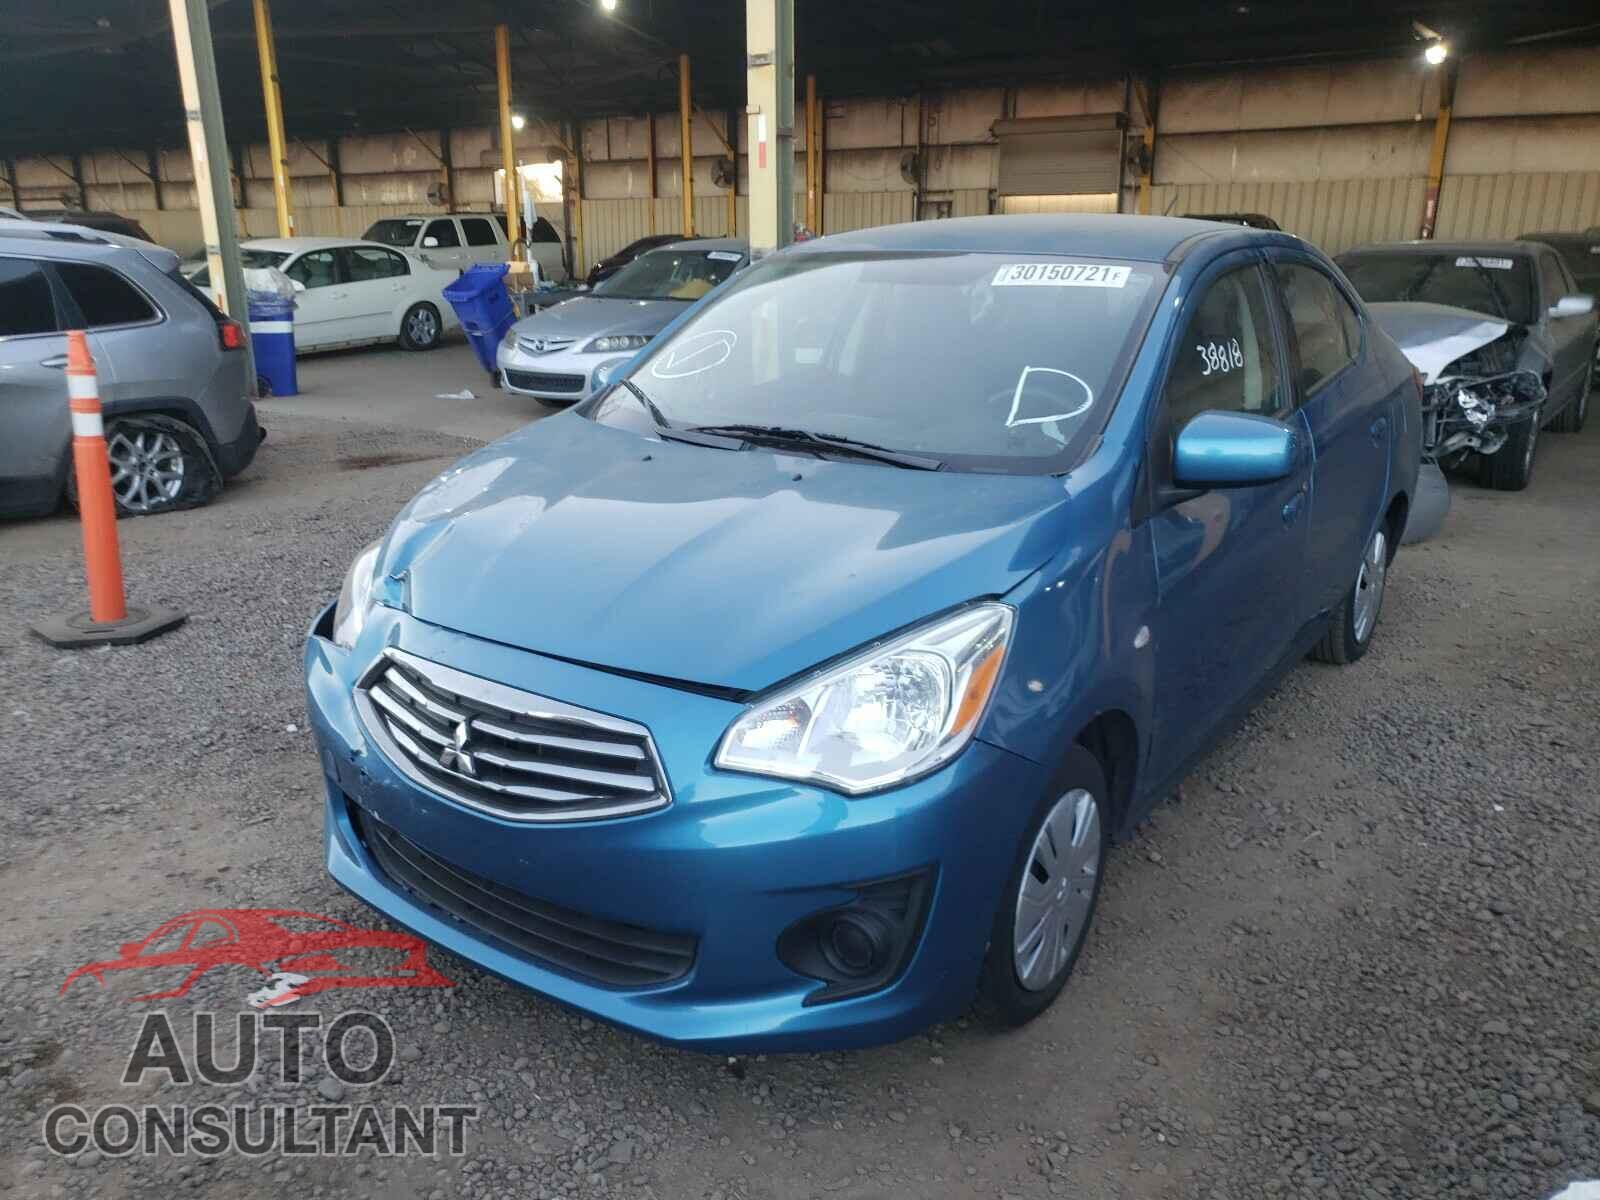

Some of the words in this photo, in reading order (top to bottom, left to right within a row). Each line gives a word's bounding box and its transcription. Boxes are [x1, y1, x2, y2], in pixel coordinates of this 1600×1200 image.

[1010, 265, 1111, 281] 30150721
[1196, 337, 1244, 376] 38818
[1004, 365, 1094, 428] D
